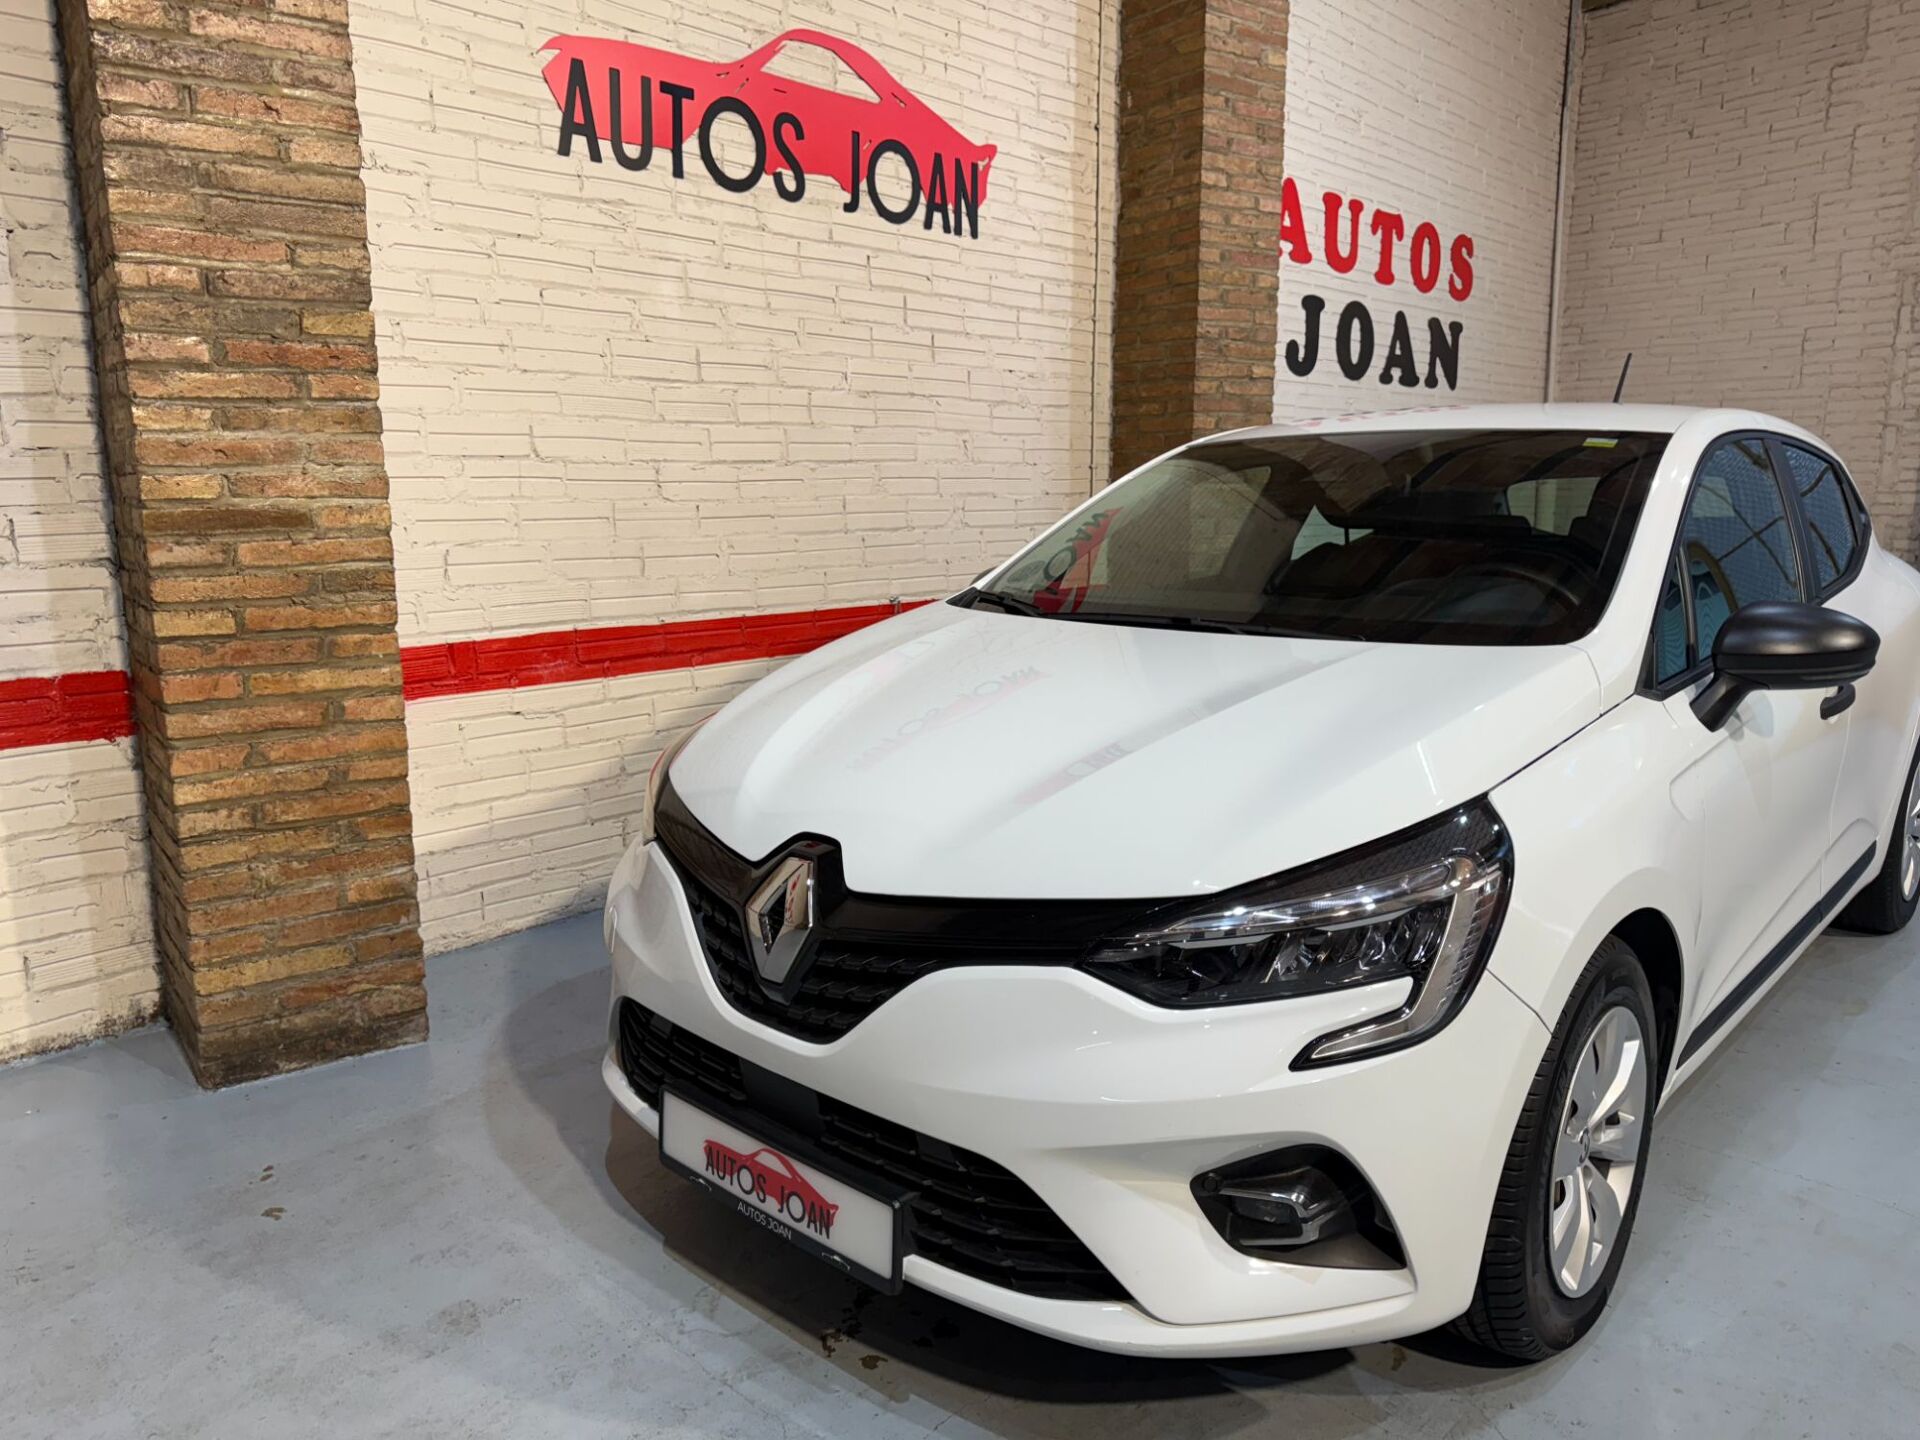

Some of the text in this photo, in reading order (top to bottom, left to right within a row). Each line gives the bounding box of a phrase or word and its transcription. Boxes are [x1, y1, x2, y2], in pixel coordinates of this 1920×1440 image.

[557, 57, 978, 239] AUTOS JOAN
[1279, 177, 1473, 302] AUTOS
[1285, 294, 1463, 391] JOAN
[705, 1145, 831, 1239] AUTOS JOAN
[737, 1201, 792, 1240] AUTOS JOAN
